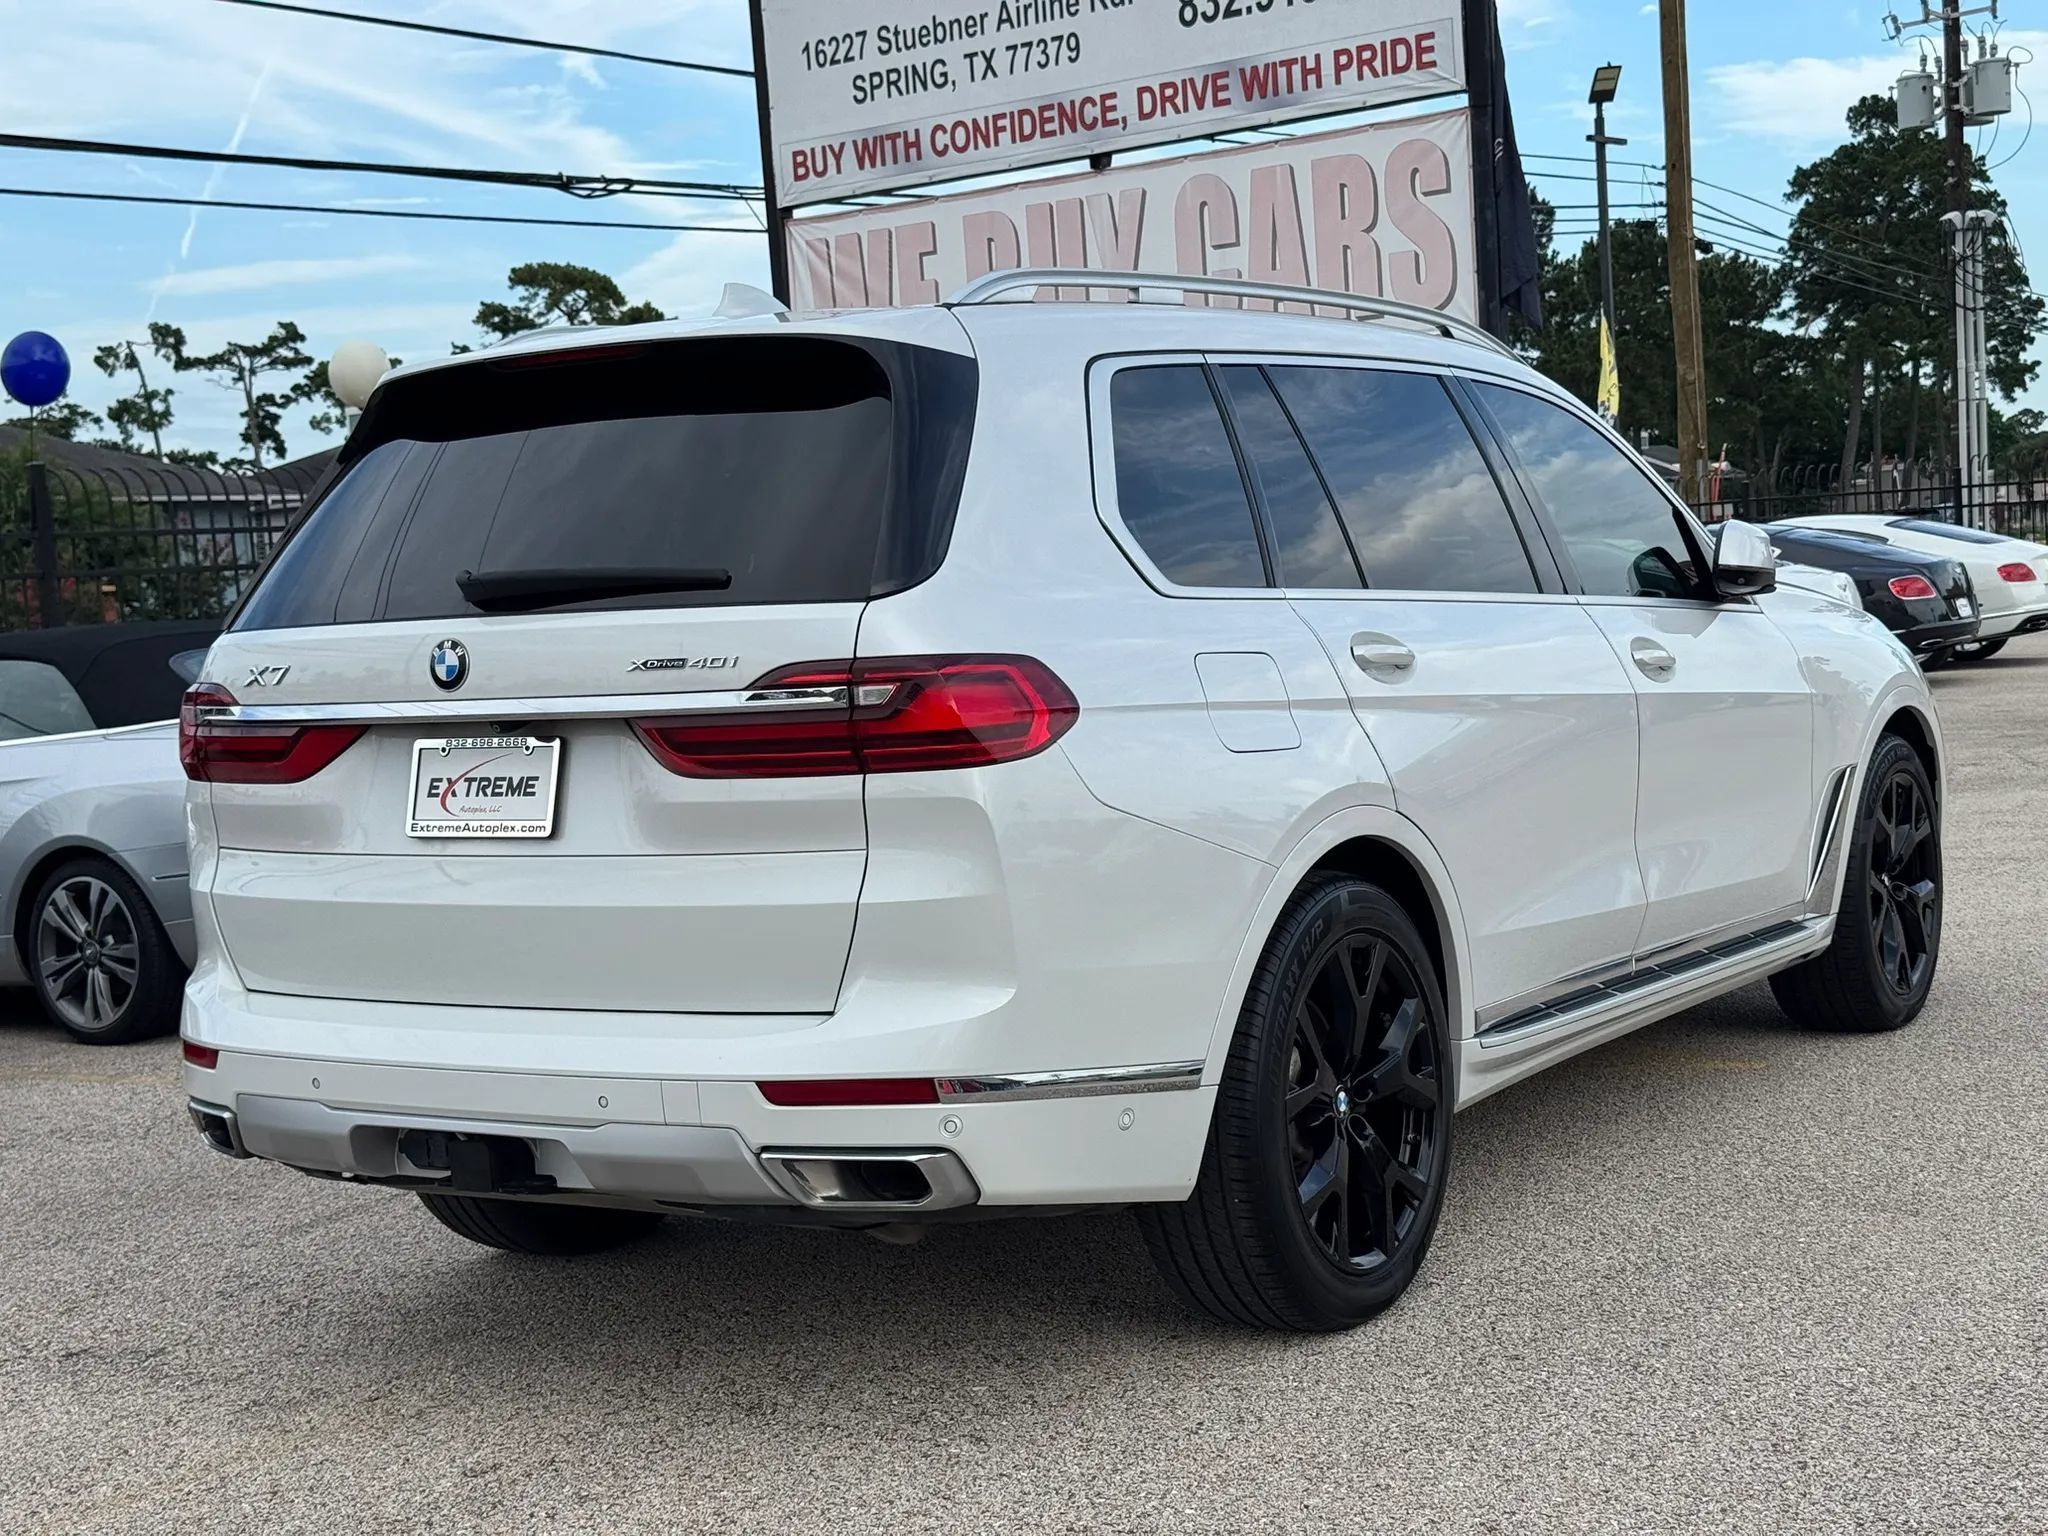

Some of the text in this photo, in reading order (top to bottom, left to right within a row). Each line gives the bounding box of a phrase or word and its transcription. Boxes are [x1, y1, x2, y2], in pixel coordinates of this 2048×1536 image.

[801, 0, 1080, 71] 16227 Stuebner Airline
[852, 32, 1081, 105] SPRING, TX 77379
[792, 32, 1437, 182] BUY WITH CONFIDENCE, DRIVE WITH PRIDE
[1174, 139, 1456, 320] CARS
[433, 641, 466, 657] BMW
[244, 665, 291, 687] X7
[427, 776, 540, 798] EXTREME
[411, 822, 546, 834] ExtremeAutoplex.com
